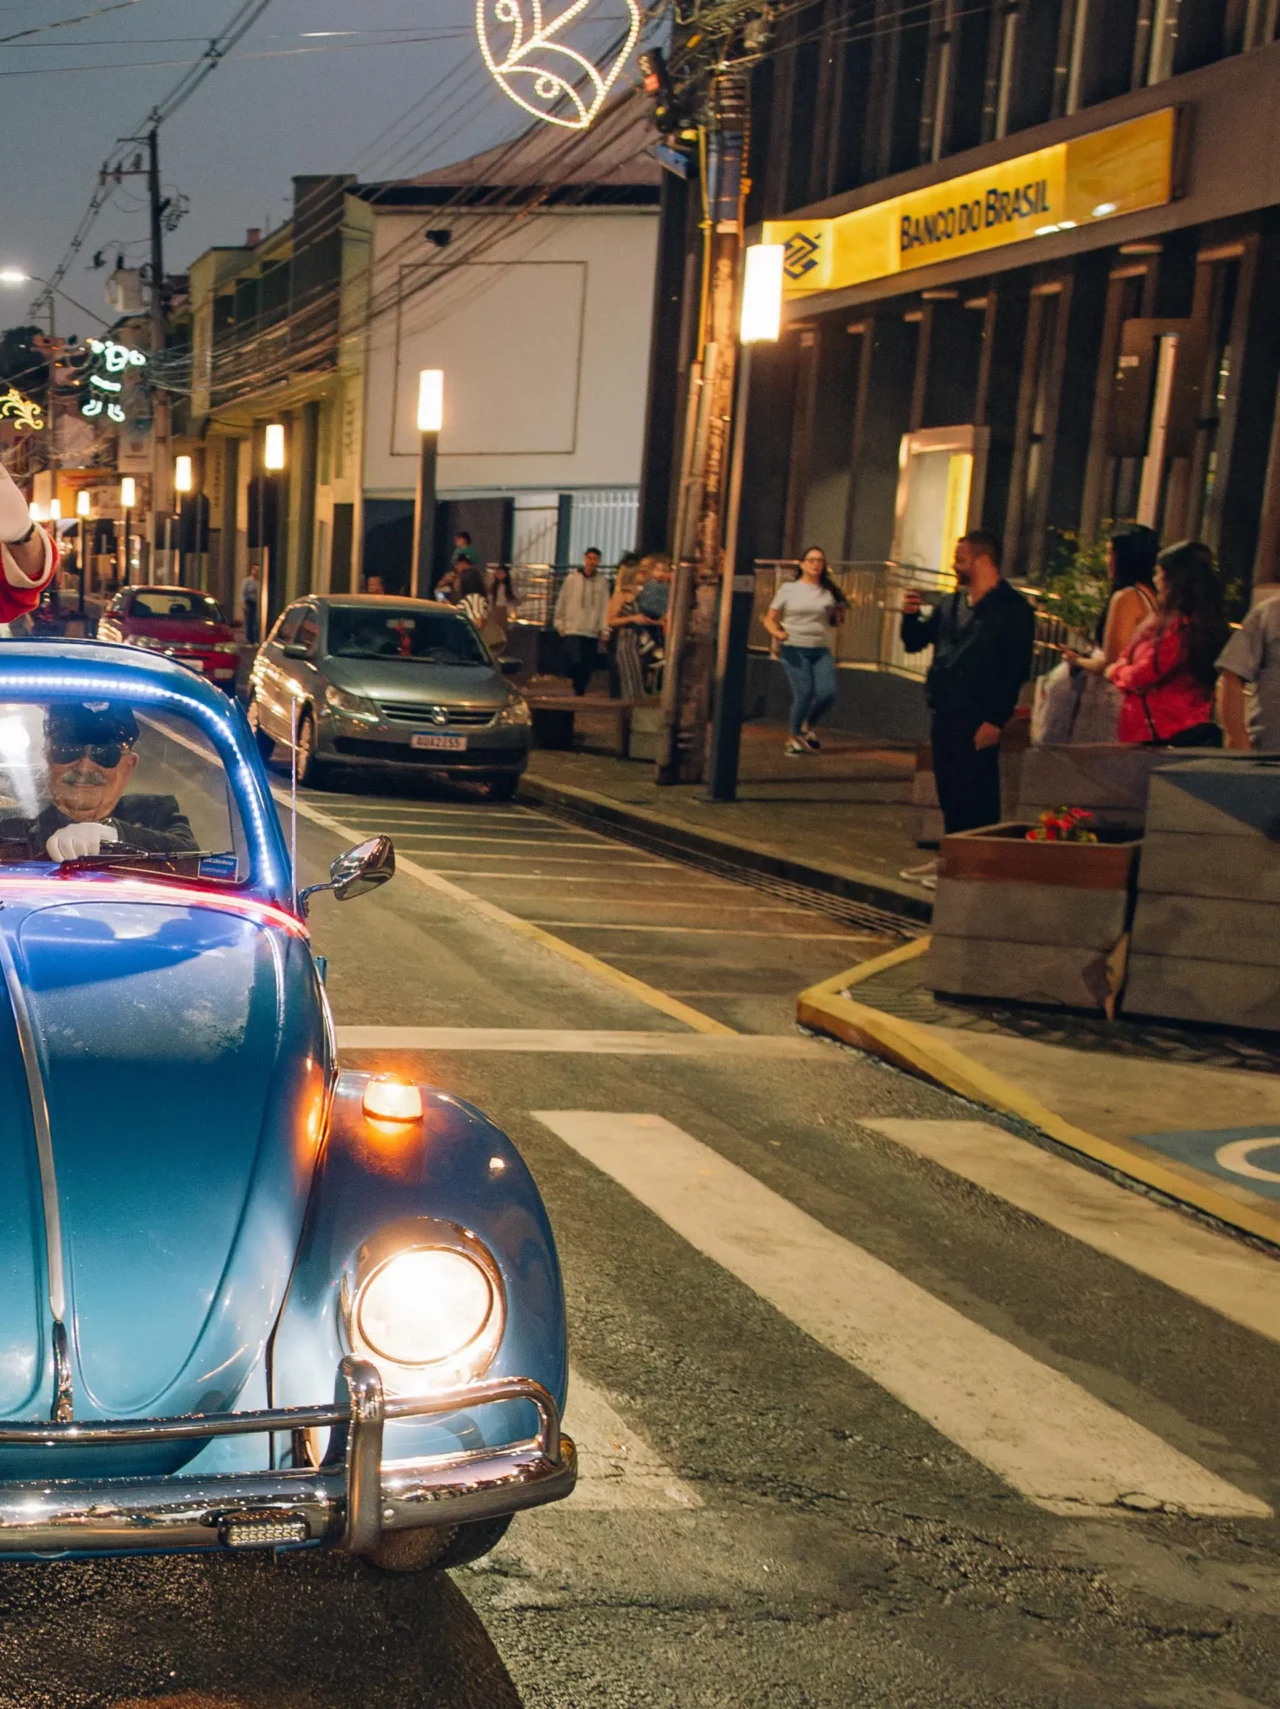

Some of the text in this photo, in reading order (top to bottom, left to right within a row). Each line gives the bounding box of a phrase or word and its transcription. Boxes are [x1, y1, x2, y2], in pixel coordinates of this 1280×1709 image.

[901, 180, 1050, 250] BANCO DO BRASIL
